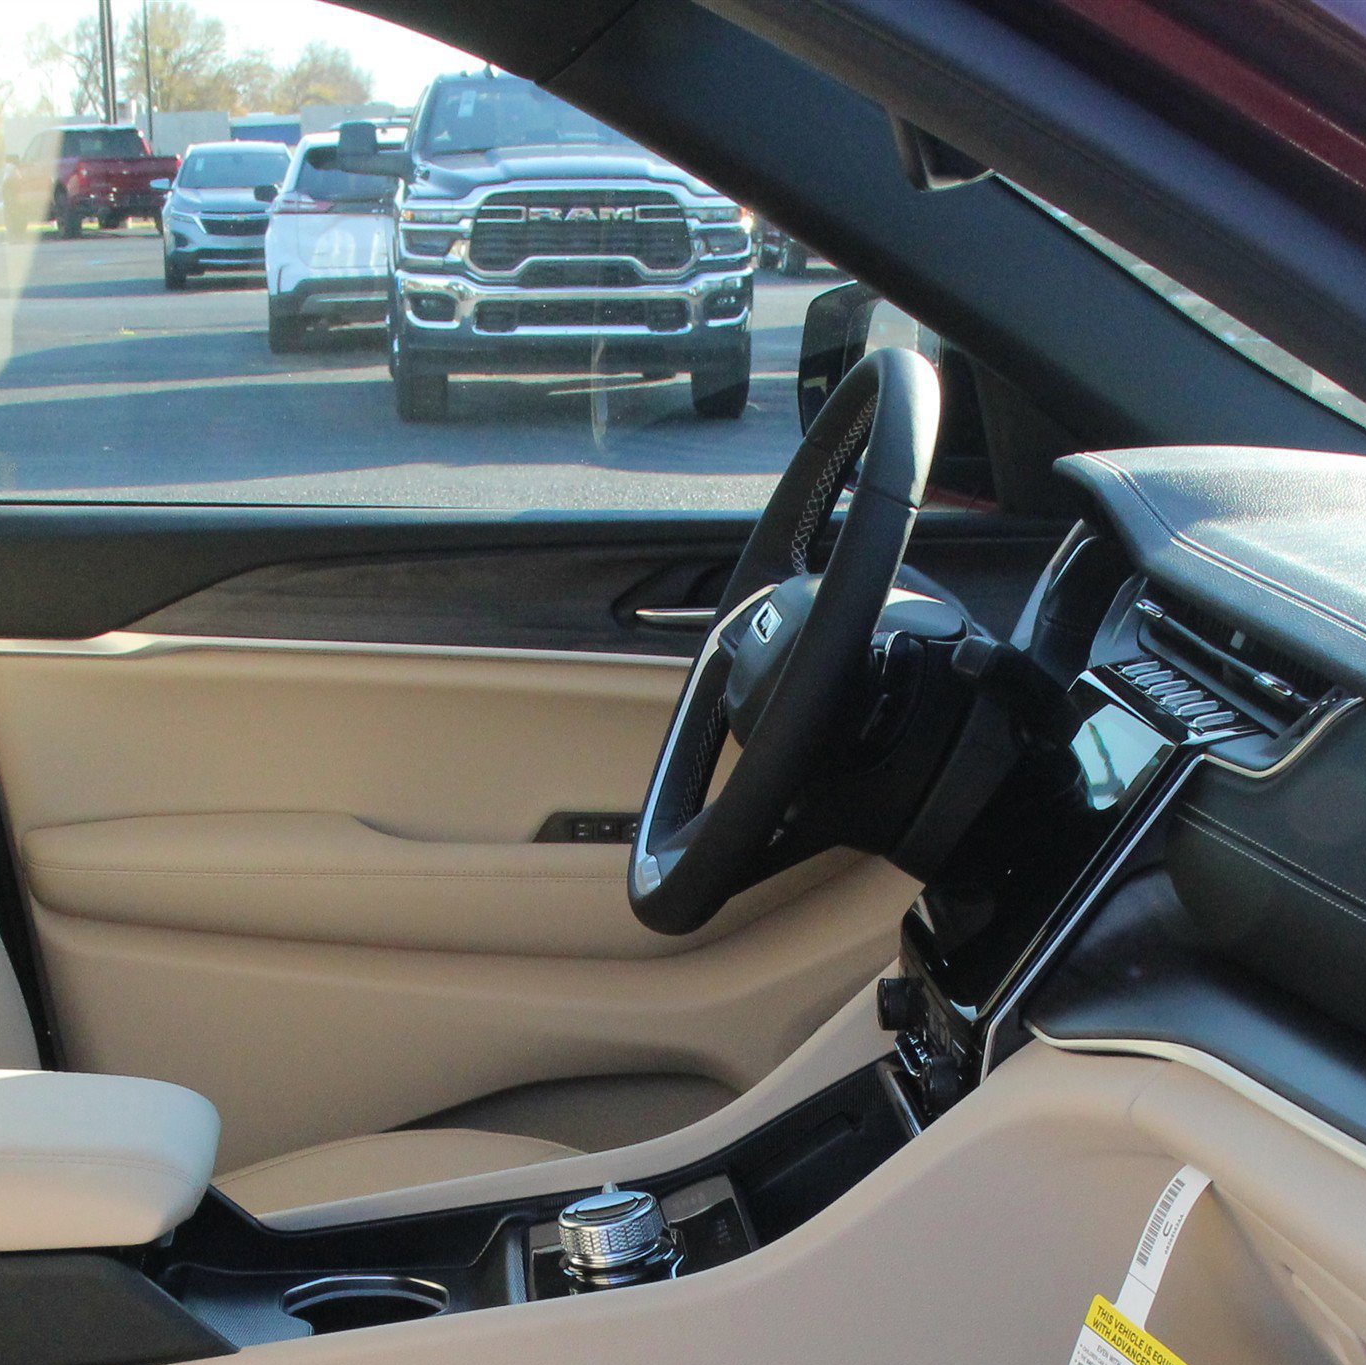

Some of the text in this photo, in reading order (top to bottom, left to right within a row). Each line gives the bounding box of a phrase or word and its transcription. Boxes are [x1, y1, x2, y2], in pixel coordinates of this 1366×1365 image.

[529, 206, 633, 221] RAM
[1092, 1317, 1110, 1337] WITH
[1096, 1305, 1113, 1325] THIS
[1113, 1319, 1144, 1349] VEHICLE
[1143, 1343, 1152, 1356] IS
